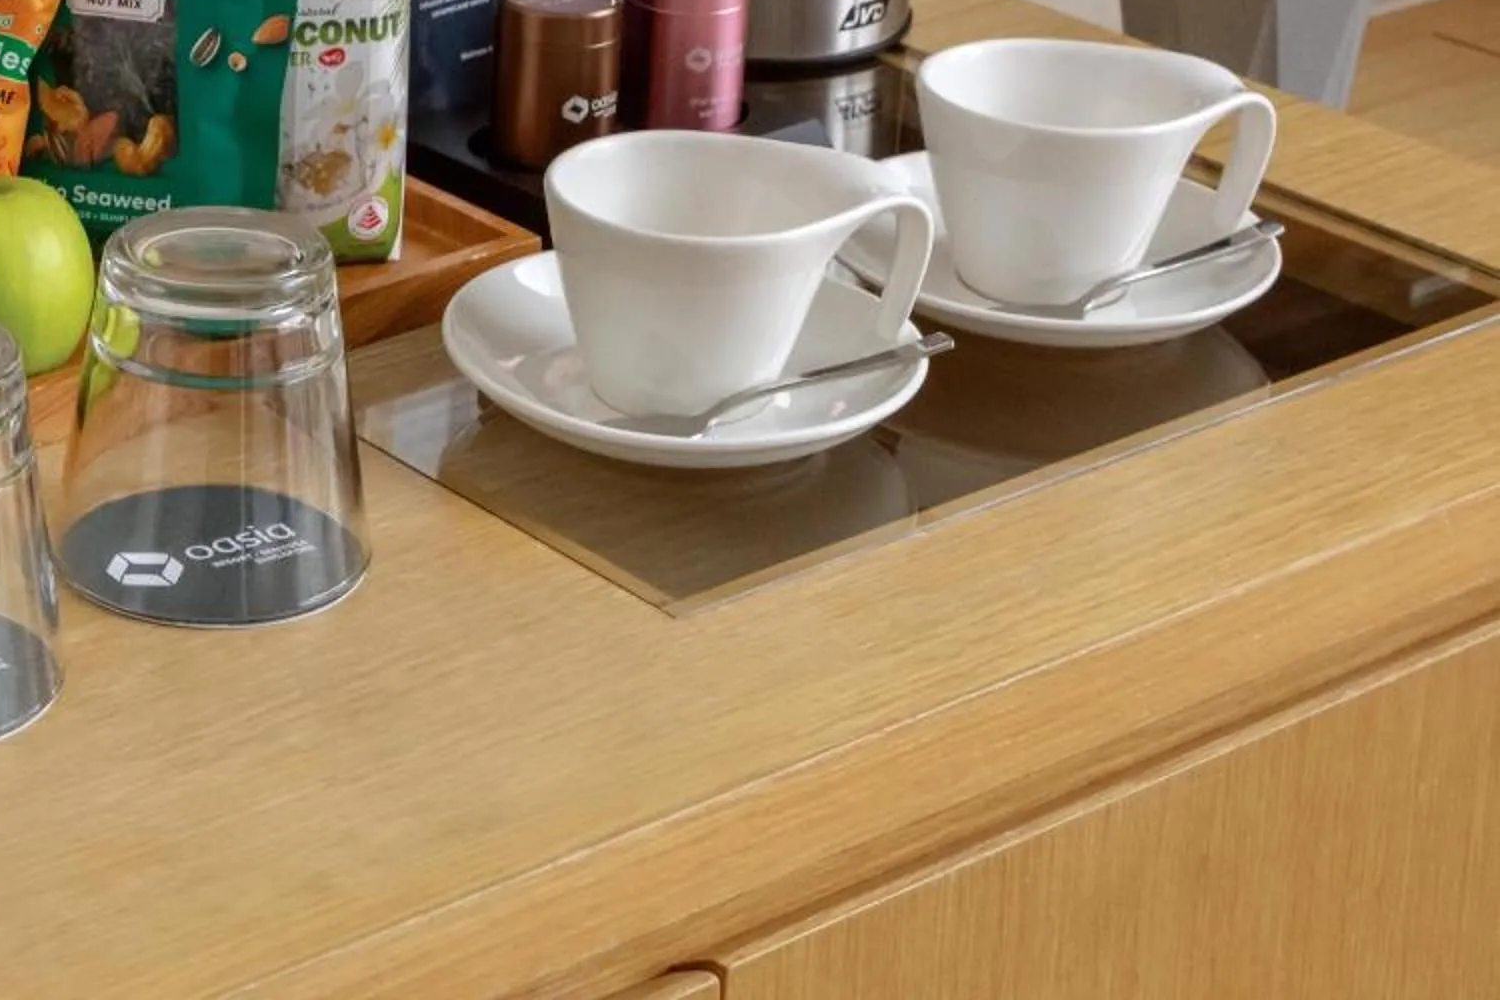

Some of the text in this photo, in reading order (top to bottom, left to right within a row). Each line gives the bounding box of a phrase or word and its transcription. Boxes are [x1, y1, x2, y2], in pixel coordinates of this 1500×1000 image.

[294, 10, 404, 47] CONUT
[72, 184, 172, 212] Seaweed
[184, 522, 296, 560] oasia
